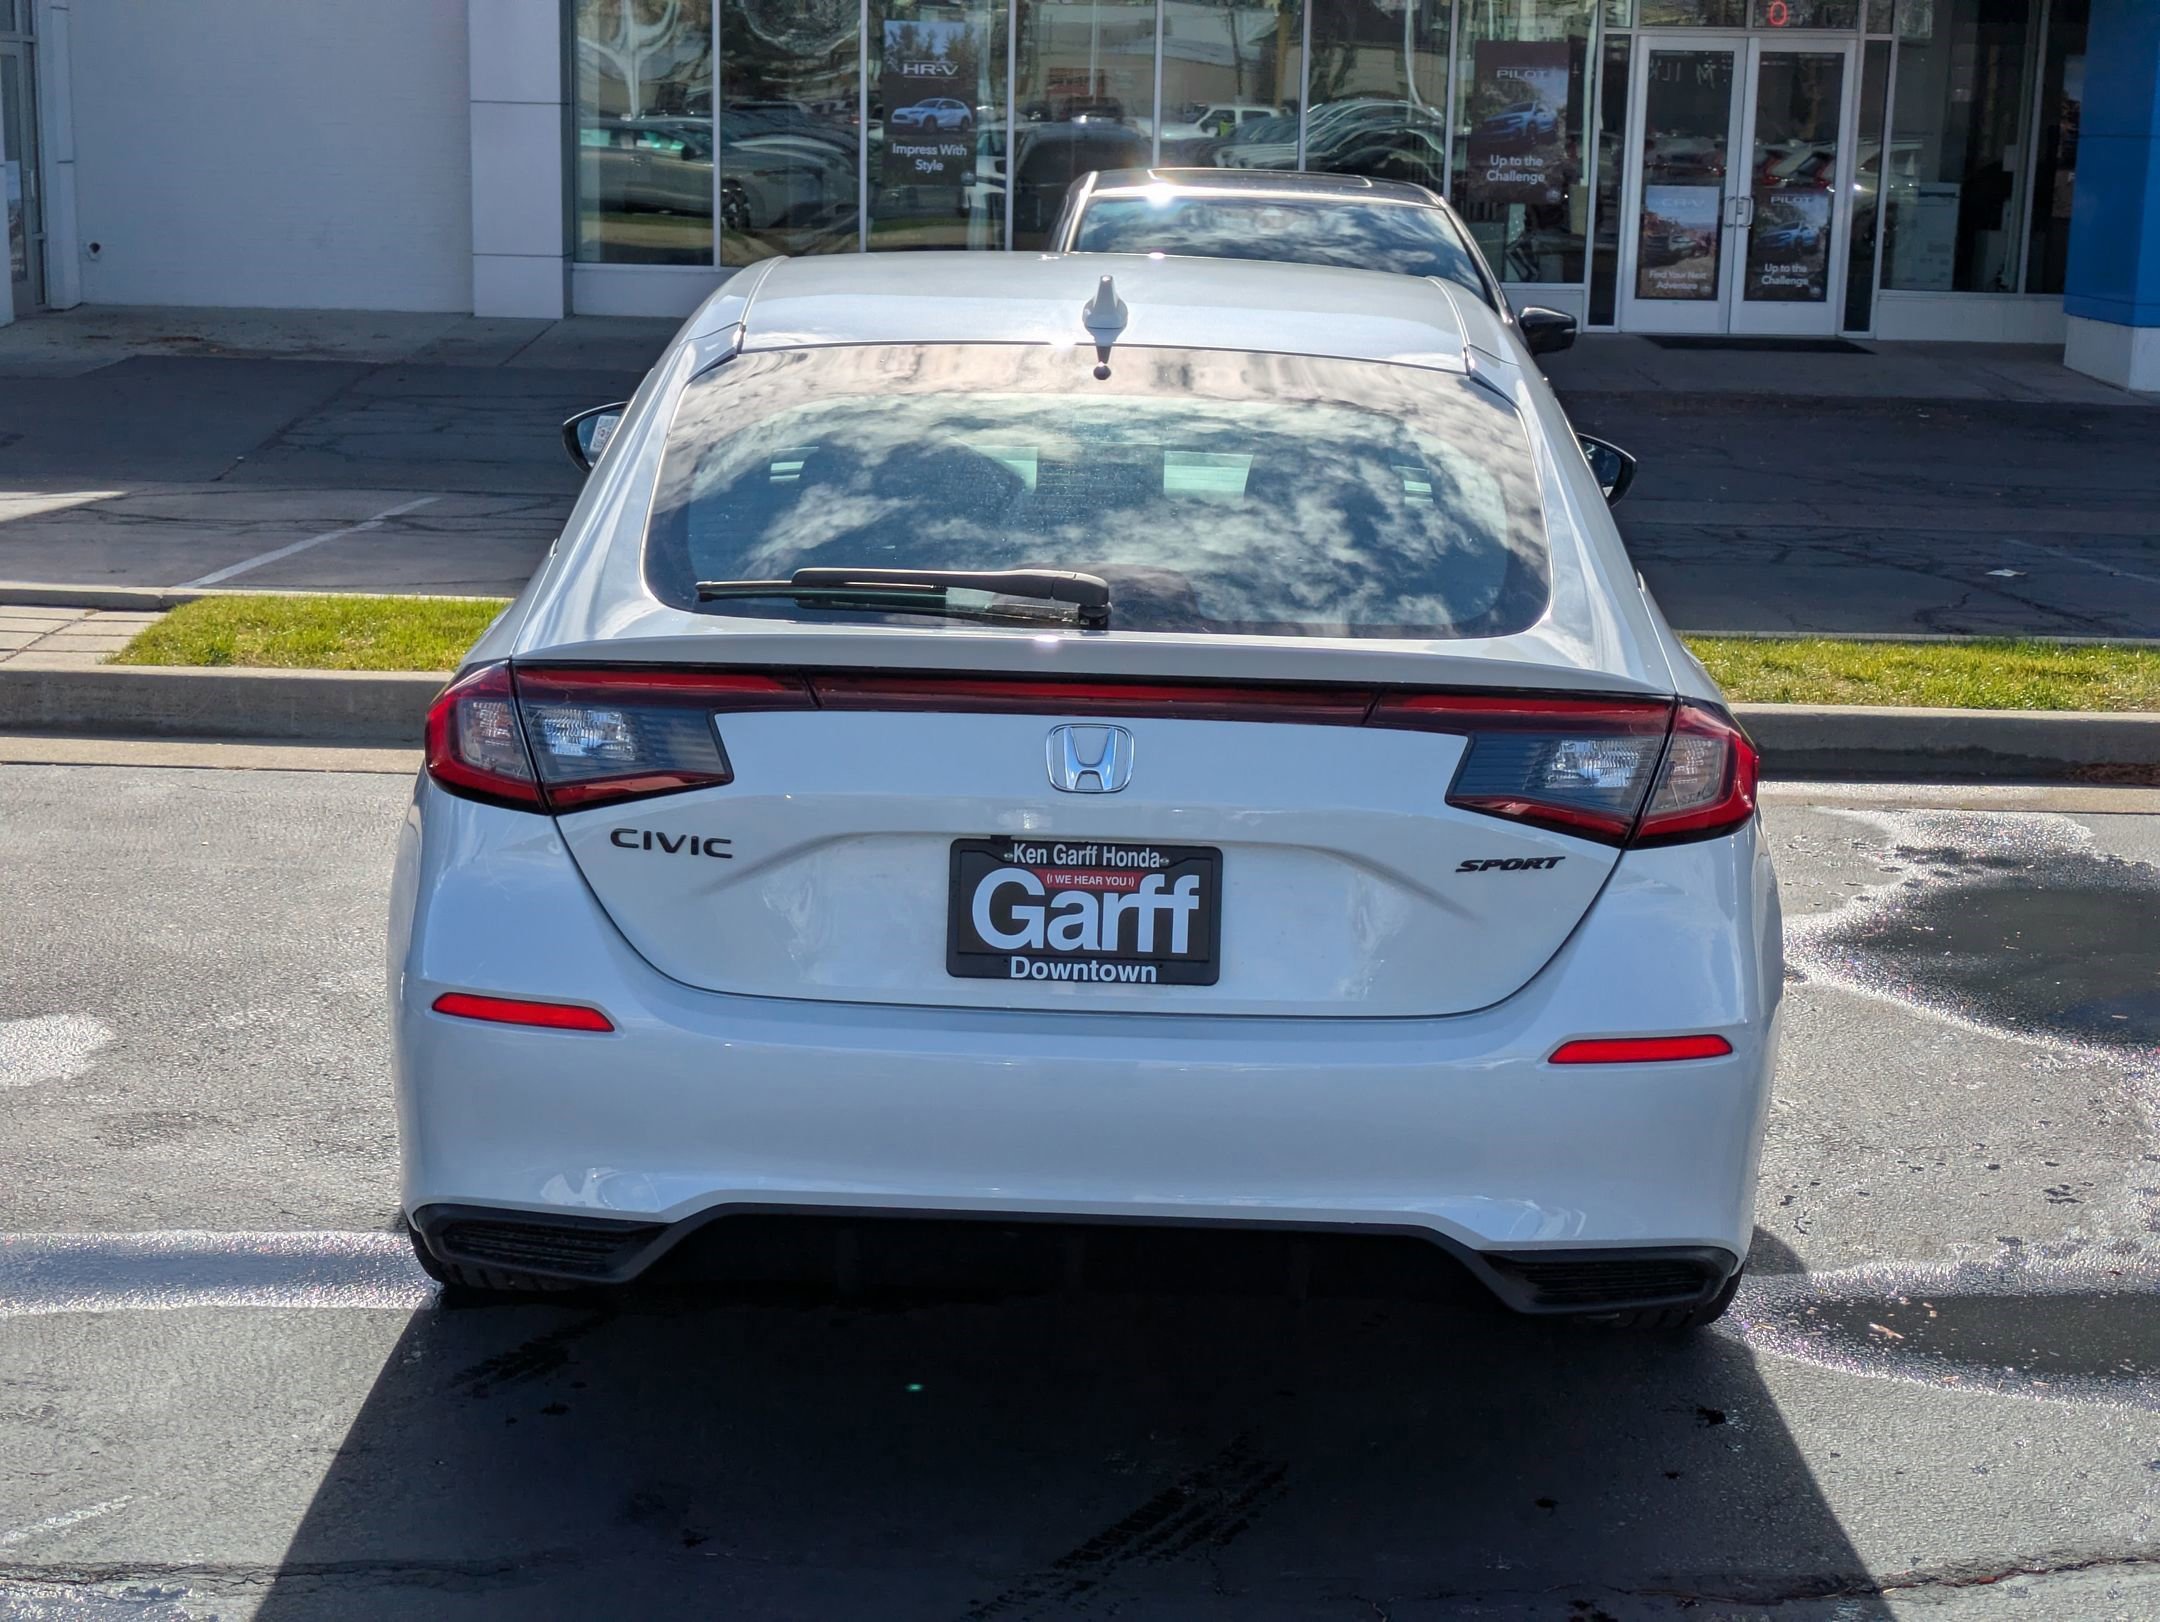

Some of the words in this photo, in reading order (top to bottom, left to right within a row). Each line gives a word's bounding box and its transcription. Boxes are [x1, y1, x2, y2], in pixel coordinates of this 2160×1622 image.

[903, 63, 959, 75] HR-V
[1496, 70, 1547, 79] PILOT
[892, 143, 938, 157] Impress
[940, 144, 967, 156] With
[915, 159, 944, 173] Style
[1490, 155, 1507, 168] Up
[1510, 156, 1522, 166] to
[1525, 155, 1544, 166] the
[1486, 170, 1545, 184] Challenge
[1771, 196, 1811, 204] PILOT
[1765, 264, 1778, 273] Up
[1792, 264, 1808, 272] the
[1761, 275, 1809, 287] Challenge
[610, 828, 733, 859] CIVIC
[1013, 843, 1047, 864] Ken
[1053, 843, 1098, 866] Garff
[1102, 846, 1160, 868] Honda
[1455, 856, 1566, 872] SPORT
[1055, 875, 1072, 884] WE
[1074, 875, 1103, 885] HEAR
[1105, 876, 1127, 886] YOU
[972, 867, 1200, 954] Garff
[1010, 956, 1157, 983] Downtown
